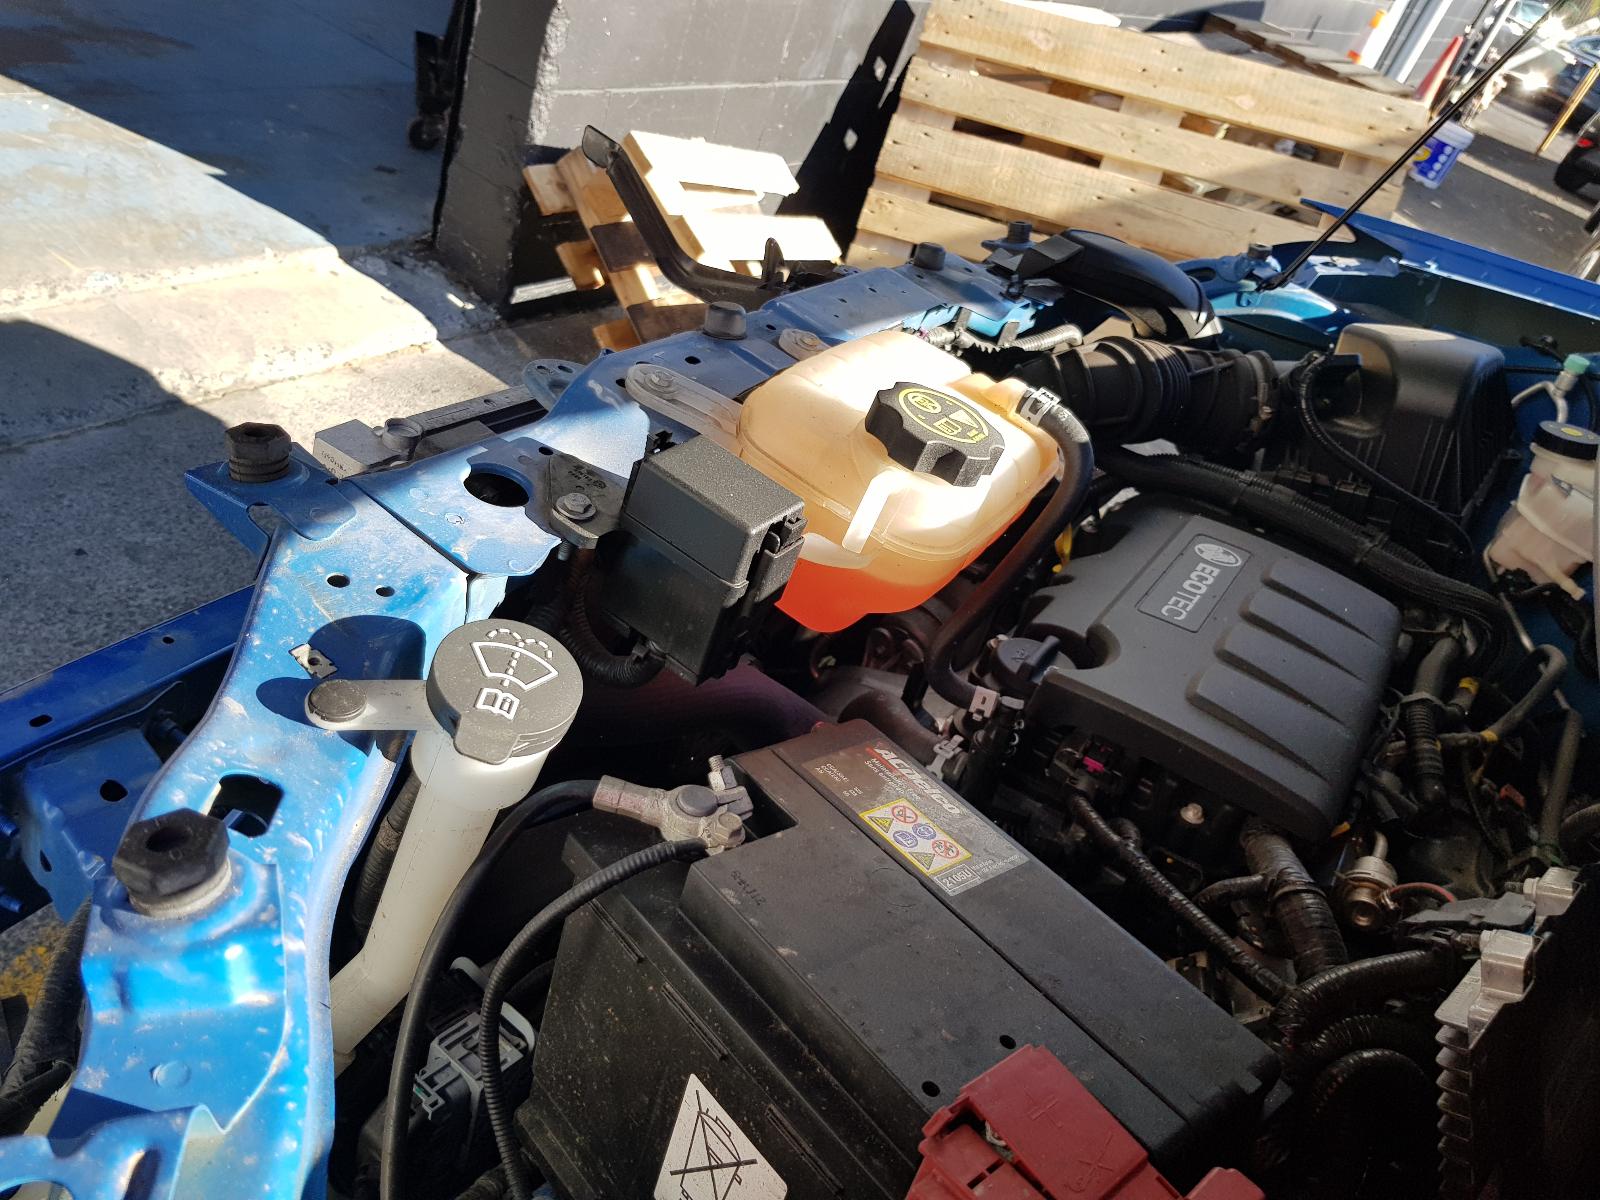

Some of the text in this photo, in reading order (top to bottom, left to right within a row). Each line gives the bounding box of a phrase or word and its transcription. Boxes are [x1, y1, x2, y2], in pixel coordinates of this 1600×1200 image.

[1161, 562, 1221, 620] ECOTEC
[873, 748, 961, 814] ACDelco
[942, 867, 973, 890] 2105U
